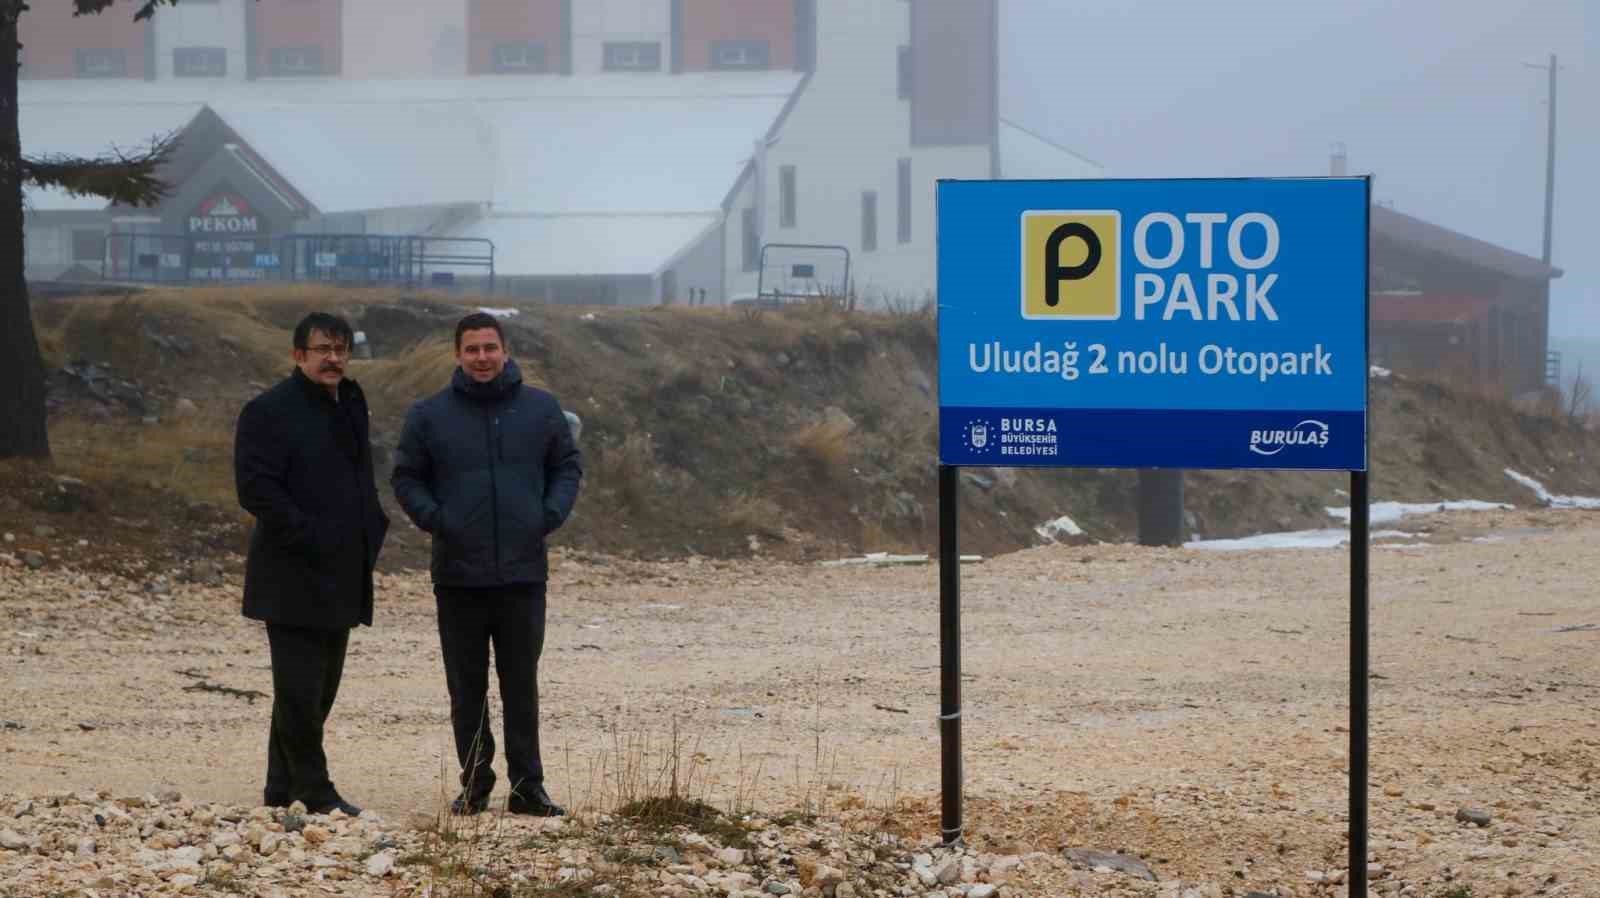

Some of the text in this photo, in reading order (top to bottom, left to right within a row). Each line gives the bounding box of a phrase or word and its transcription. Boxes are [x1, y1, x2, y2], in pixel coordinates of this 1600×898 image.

[189, 216, 257, 232] PEKOM
[1133, 212, 1280, 269] OTO
[1045, 222, 1102, 308] P
[1134, 273, 1279, 321] PARK
[968, 341, 1333, 382] Uludağ 2 nolu Otopark
[1001, 418, 1057, 432] BURSA
[1250, 430, 1329, 448] BURULAŞ
[1001, 444, 1058, 455] BELEDİYESİ
